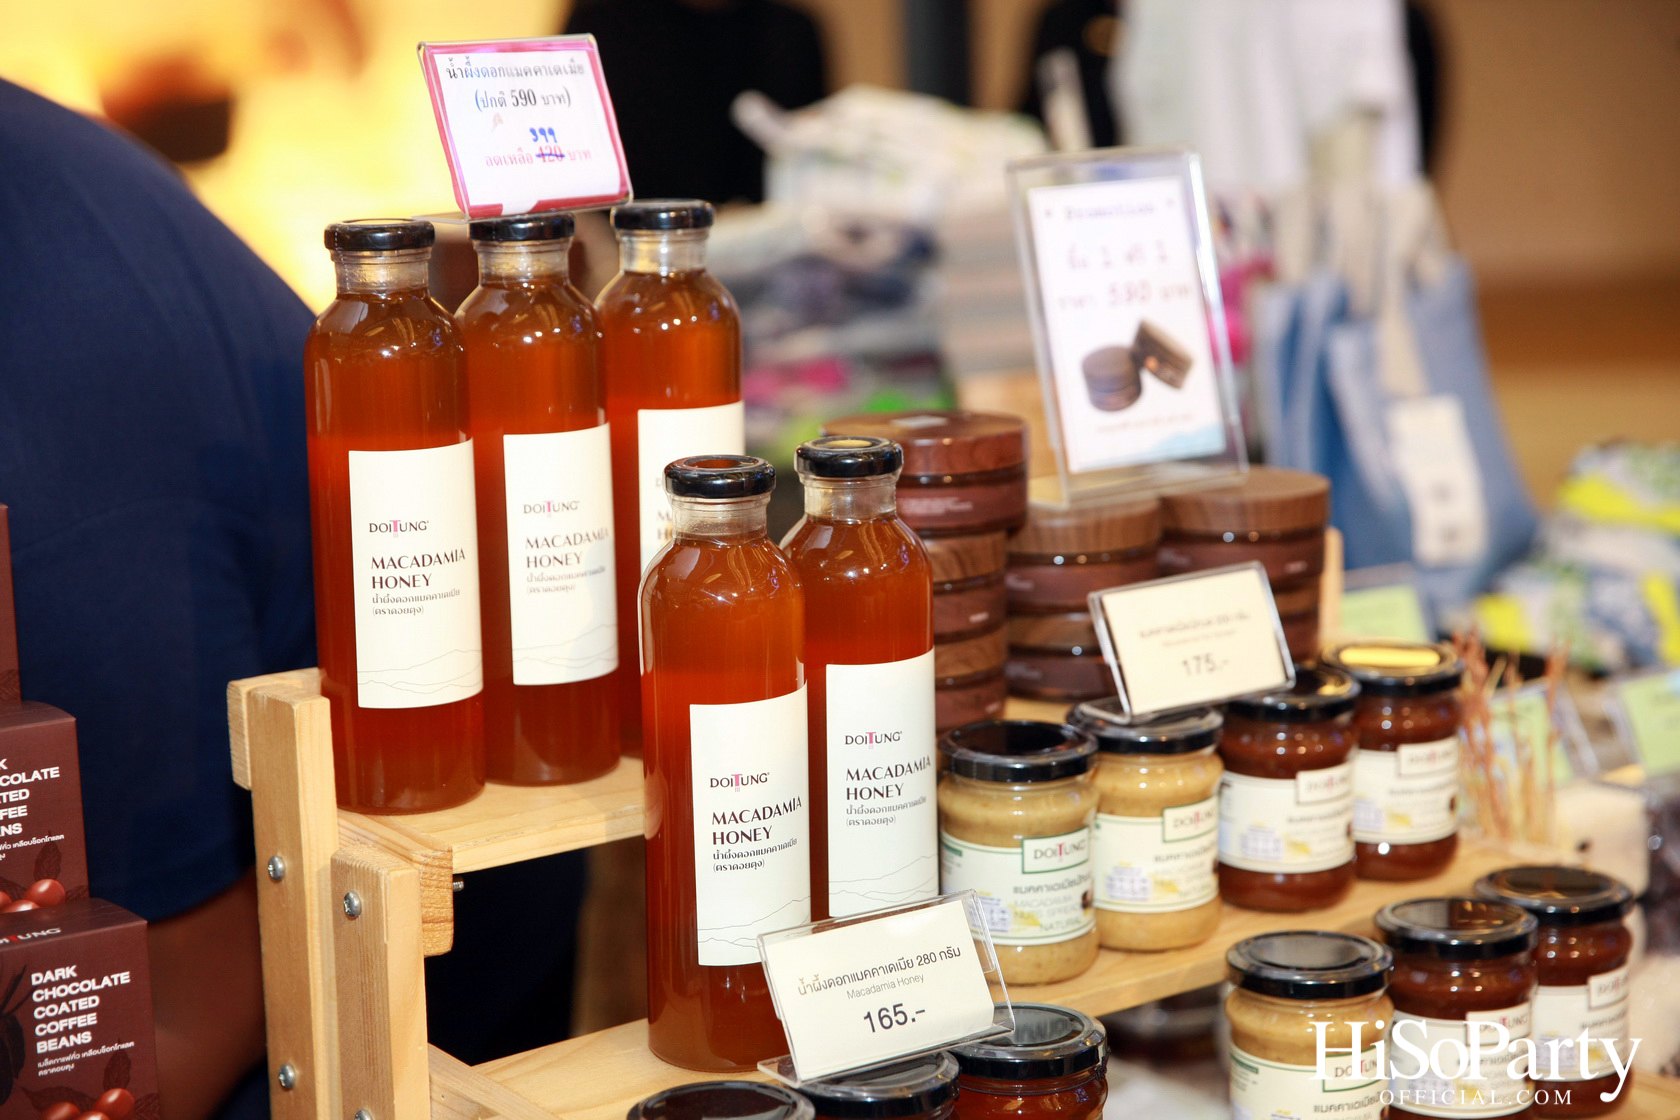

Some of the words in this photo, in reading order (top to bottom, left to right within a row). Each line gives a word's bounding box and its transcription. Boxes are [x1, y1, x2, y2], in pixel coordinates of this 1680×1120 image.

[511, 88, 537, 107] 590
[525, 528, 609, 549] MACADAMIA
[371, 548, 465, 569] MACADAMIA
[526, 551, 583, 568] HONEY
[372, 573, 432, 589] HONEY
[845, 755, 931, 781] MACADAMIA
[846, 783, 904, 801] HONEY
[711, 796, 802, 825] MACADAMIA
[712, 825, 772, 845] HONEY
[31, 965, 77, 985] DARK
[798, 957, 914, 996] น้ำผึ้งดอกแมคคาเดเมีย
[916, 952, 937, 967] 280
[939, 946, 961, 960] กรัม
[32, 971, 131, 1002] CHOCOLATE
[846, 979, 896, 1000] Macadamia
[897, 973, 924, 988] Honey
[34, 996, 100, 1019] COATED
[863, 1003, 926, 1033] 165.-
[35, 1013, 97, 1036] COFFEE
[37, 1031, 92, 1054] BEANS
